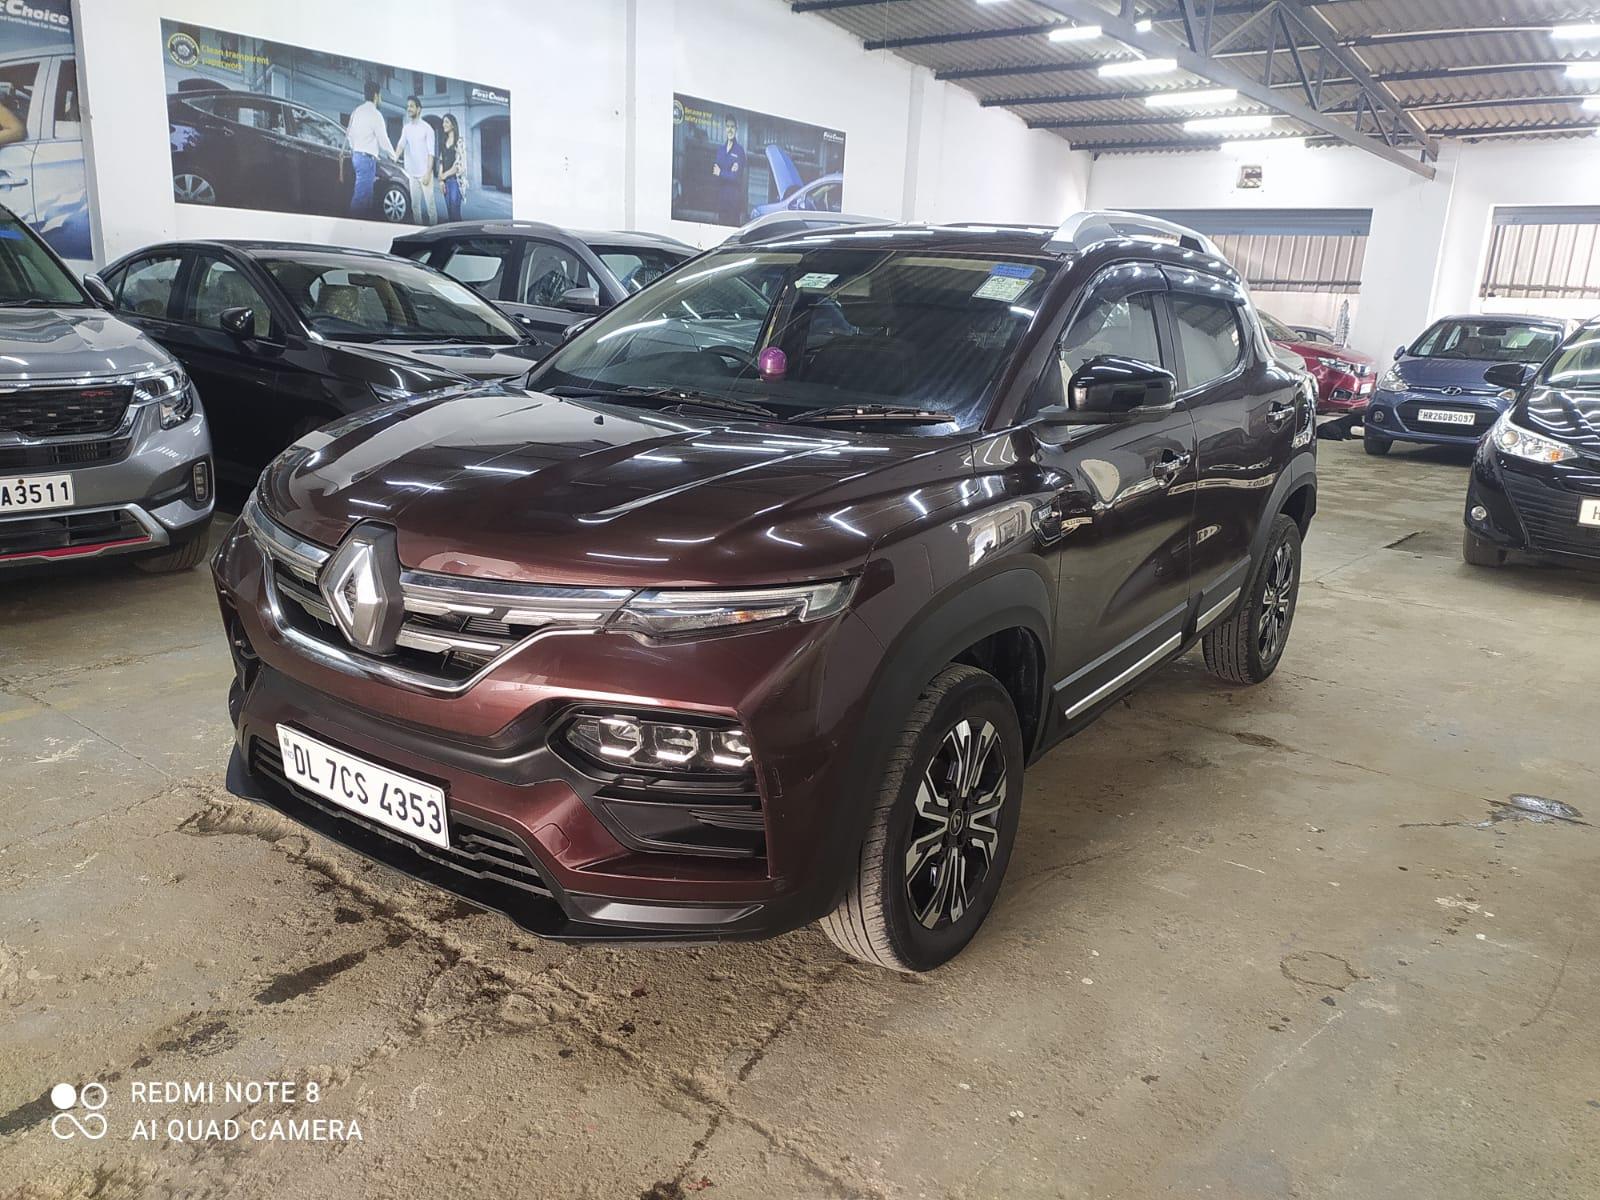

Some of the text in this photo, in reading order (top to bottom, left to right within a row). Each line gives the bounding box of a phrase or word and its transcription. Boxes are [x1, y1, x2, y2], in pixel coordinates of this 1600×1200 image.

[225, 50, 269, 65] transparent
[1, 481, 69, 506] A3511
[293, 743, 442, 834] DL 7CS 4353
